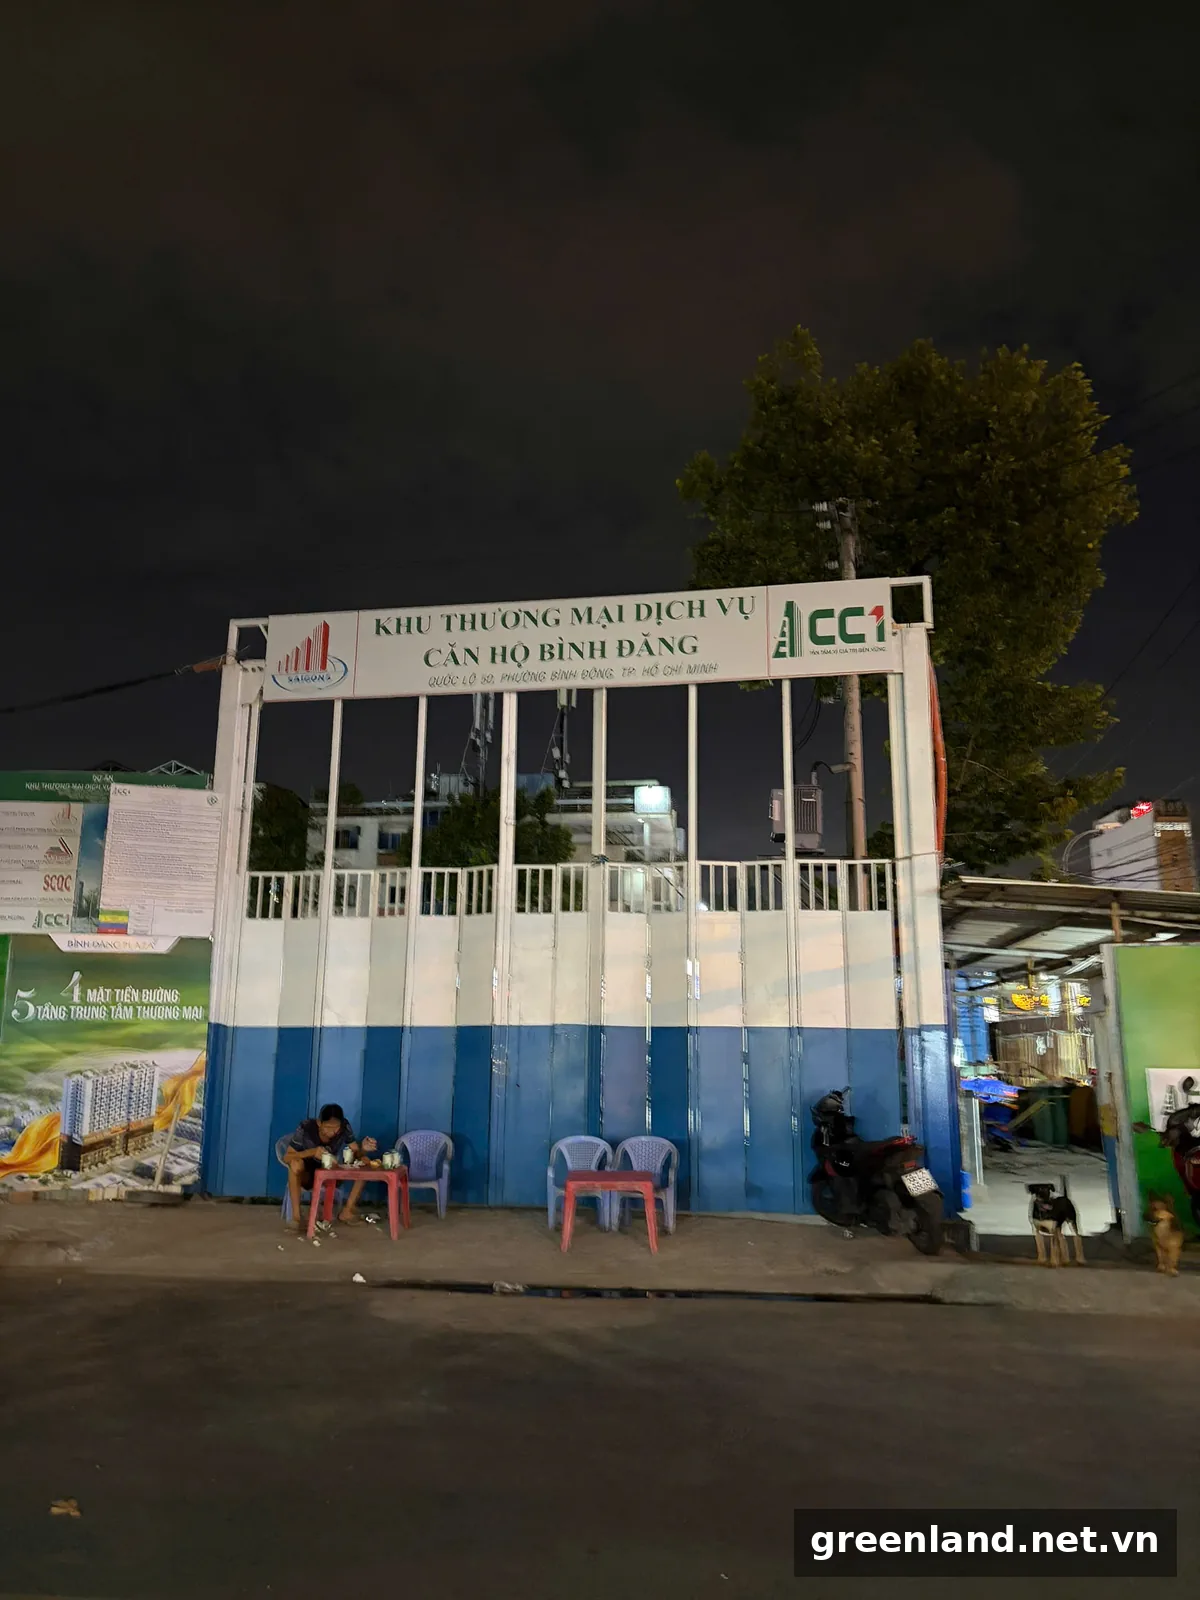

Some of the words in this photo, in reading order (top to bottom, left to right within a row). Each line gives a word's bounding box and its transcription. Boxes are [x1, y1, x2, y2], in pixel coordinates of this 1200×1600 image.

[375, 614, 432, 636] KHU
[440, 607, 561, 633] THƯƠNG
[570, 603, 625, 629] MẠI
[634, 599, 706, 625] DỊCH
[716, 595, 756, 621] VỤ
[424, 642, 479, 668] CĂN
[490, 640, 530, 669] HỘ
[539, 636, 607, 662] BÌNH
[616, 631, 699, 658] ĐĂNG
[428, 672, 459, 688] QUỐC
[462, 672, 477, 685] LỘ
[500, 669, 546, 684] PHƯỜNG
[550, 668, 578, 682] BÌNH
[663, 661, 683, 677] CHÍ
[686, 662, 719, 675] MINH
[67, 938, 90, 949] BÌNH
[11, 987, 36, 1023] 5
[36, 1001, 69, 1020] TẦNG
[70, 1006, 108, 1021] TRUNG
[110, 1003, 133, 1020] TÂM
[136, 1005, 181, 1021] THƯƠNG
[182, 1006, 204, 1022] MẠI
[60, 970, 83, 1004] 4
[86, 987, 112, 1005] MẶT
[114, 985, 140, 1004] TIỀN
[142, 985, 181, 1004] ĐƯỜNG
